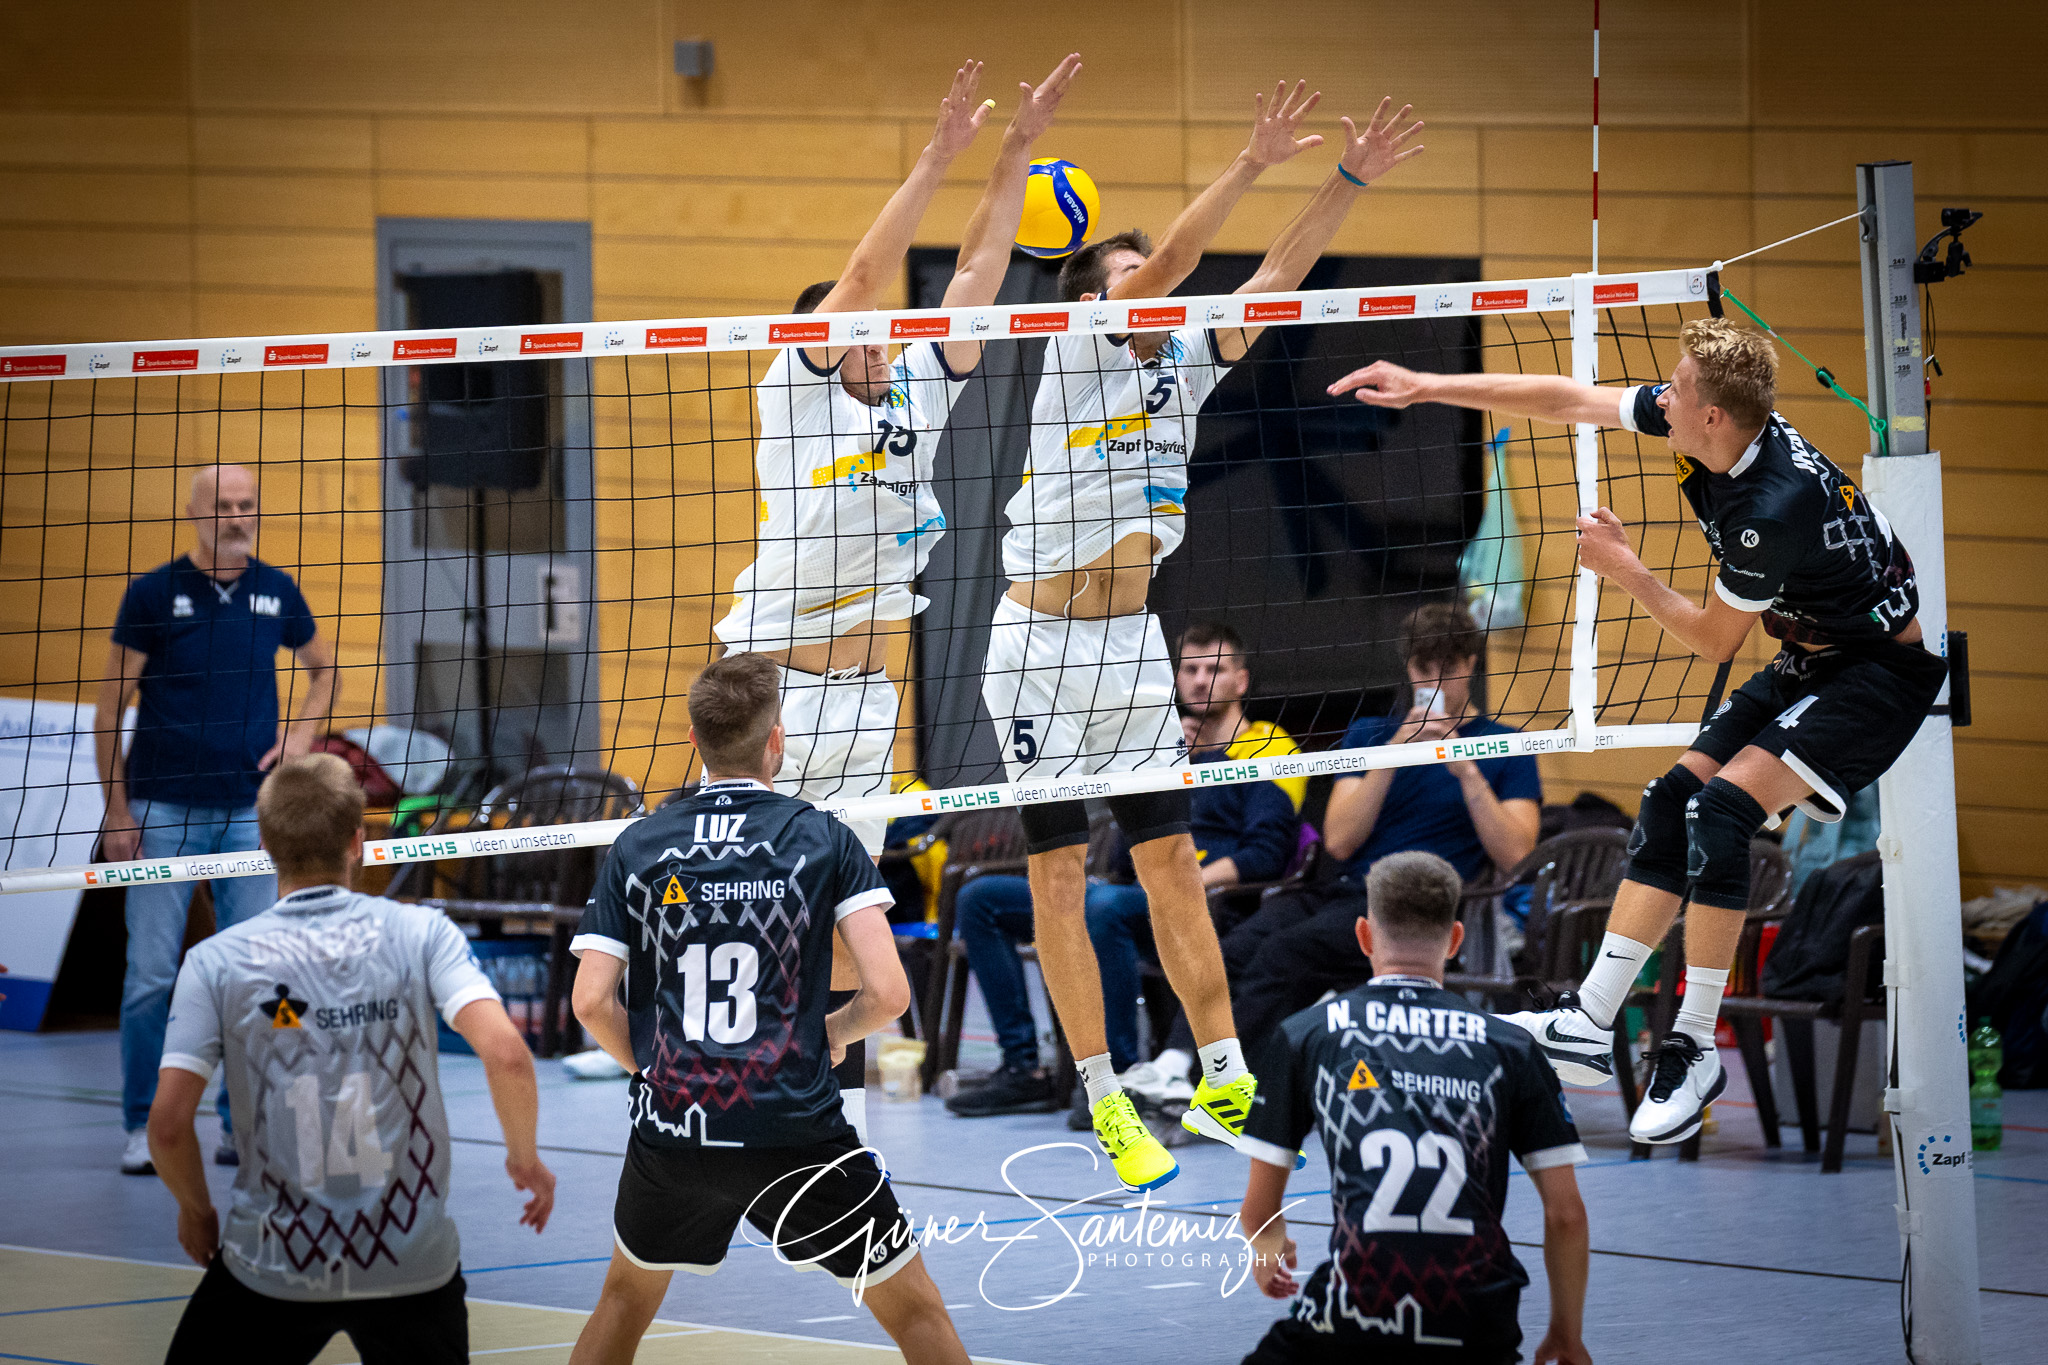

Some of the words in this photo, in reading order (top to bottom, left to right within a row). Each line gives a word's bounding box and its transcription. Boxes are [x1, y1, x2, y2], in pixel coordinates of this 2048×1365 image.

[1146, 376, 1176, 414] 5
[1109, 439, 1141, 454] Zapf
[1774, 695, 1819, 729] 4
[1014, 720, 1037, 764] 5
[1453, 741, 1509, 757] FUCHS
[1522, 738, 1553, 752] Ideen
[1557, 734, 1614, 748] umzen
[1200, 765, 1259, 783] FUCHS
[1271, 762, 1304, 776] Ideen
[1308, 755, 1367, 772] umsetzen
[940, 791, 1000, 809] FUCHS
[1012, 788, 1047, 802] Ideen
[1051, 781, 1111, 798] umsetzen
[693, 814, 747, 843] LUZ
[392, 841, 458, 859] FUCHS
[470, 838, 507, 853] Ideen
[512, 831, 576, 848] umsetzen
[105, 865, 172, 883] FUCHS
[186, 861, 224, 876] Ideen
[228, 857, 277, 873] umset
[701, 880, 785, 901] SEHRING
[677, 942, 759, 1044] 13
[316, 999, 398, 1030] SEHRING
[1327, 999, 1358, 1033] N.
[1366, 1001, 1487, 1044] CARTER
[1391, 1070, 1481, 1102] SEHRING
[285, 1072, 393, 1187] 14
[1932, 1152, 1965, 1168] Zapf
[1360, 1128, 1475, 1236] 22
